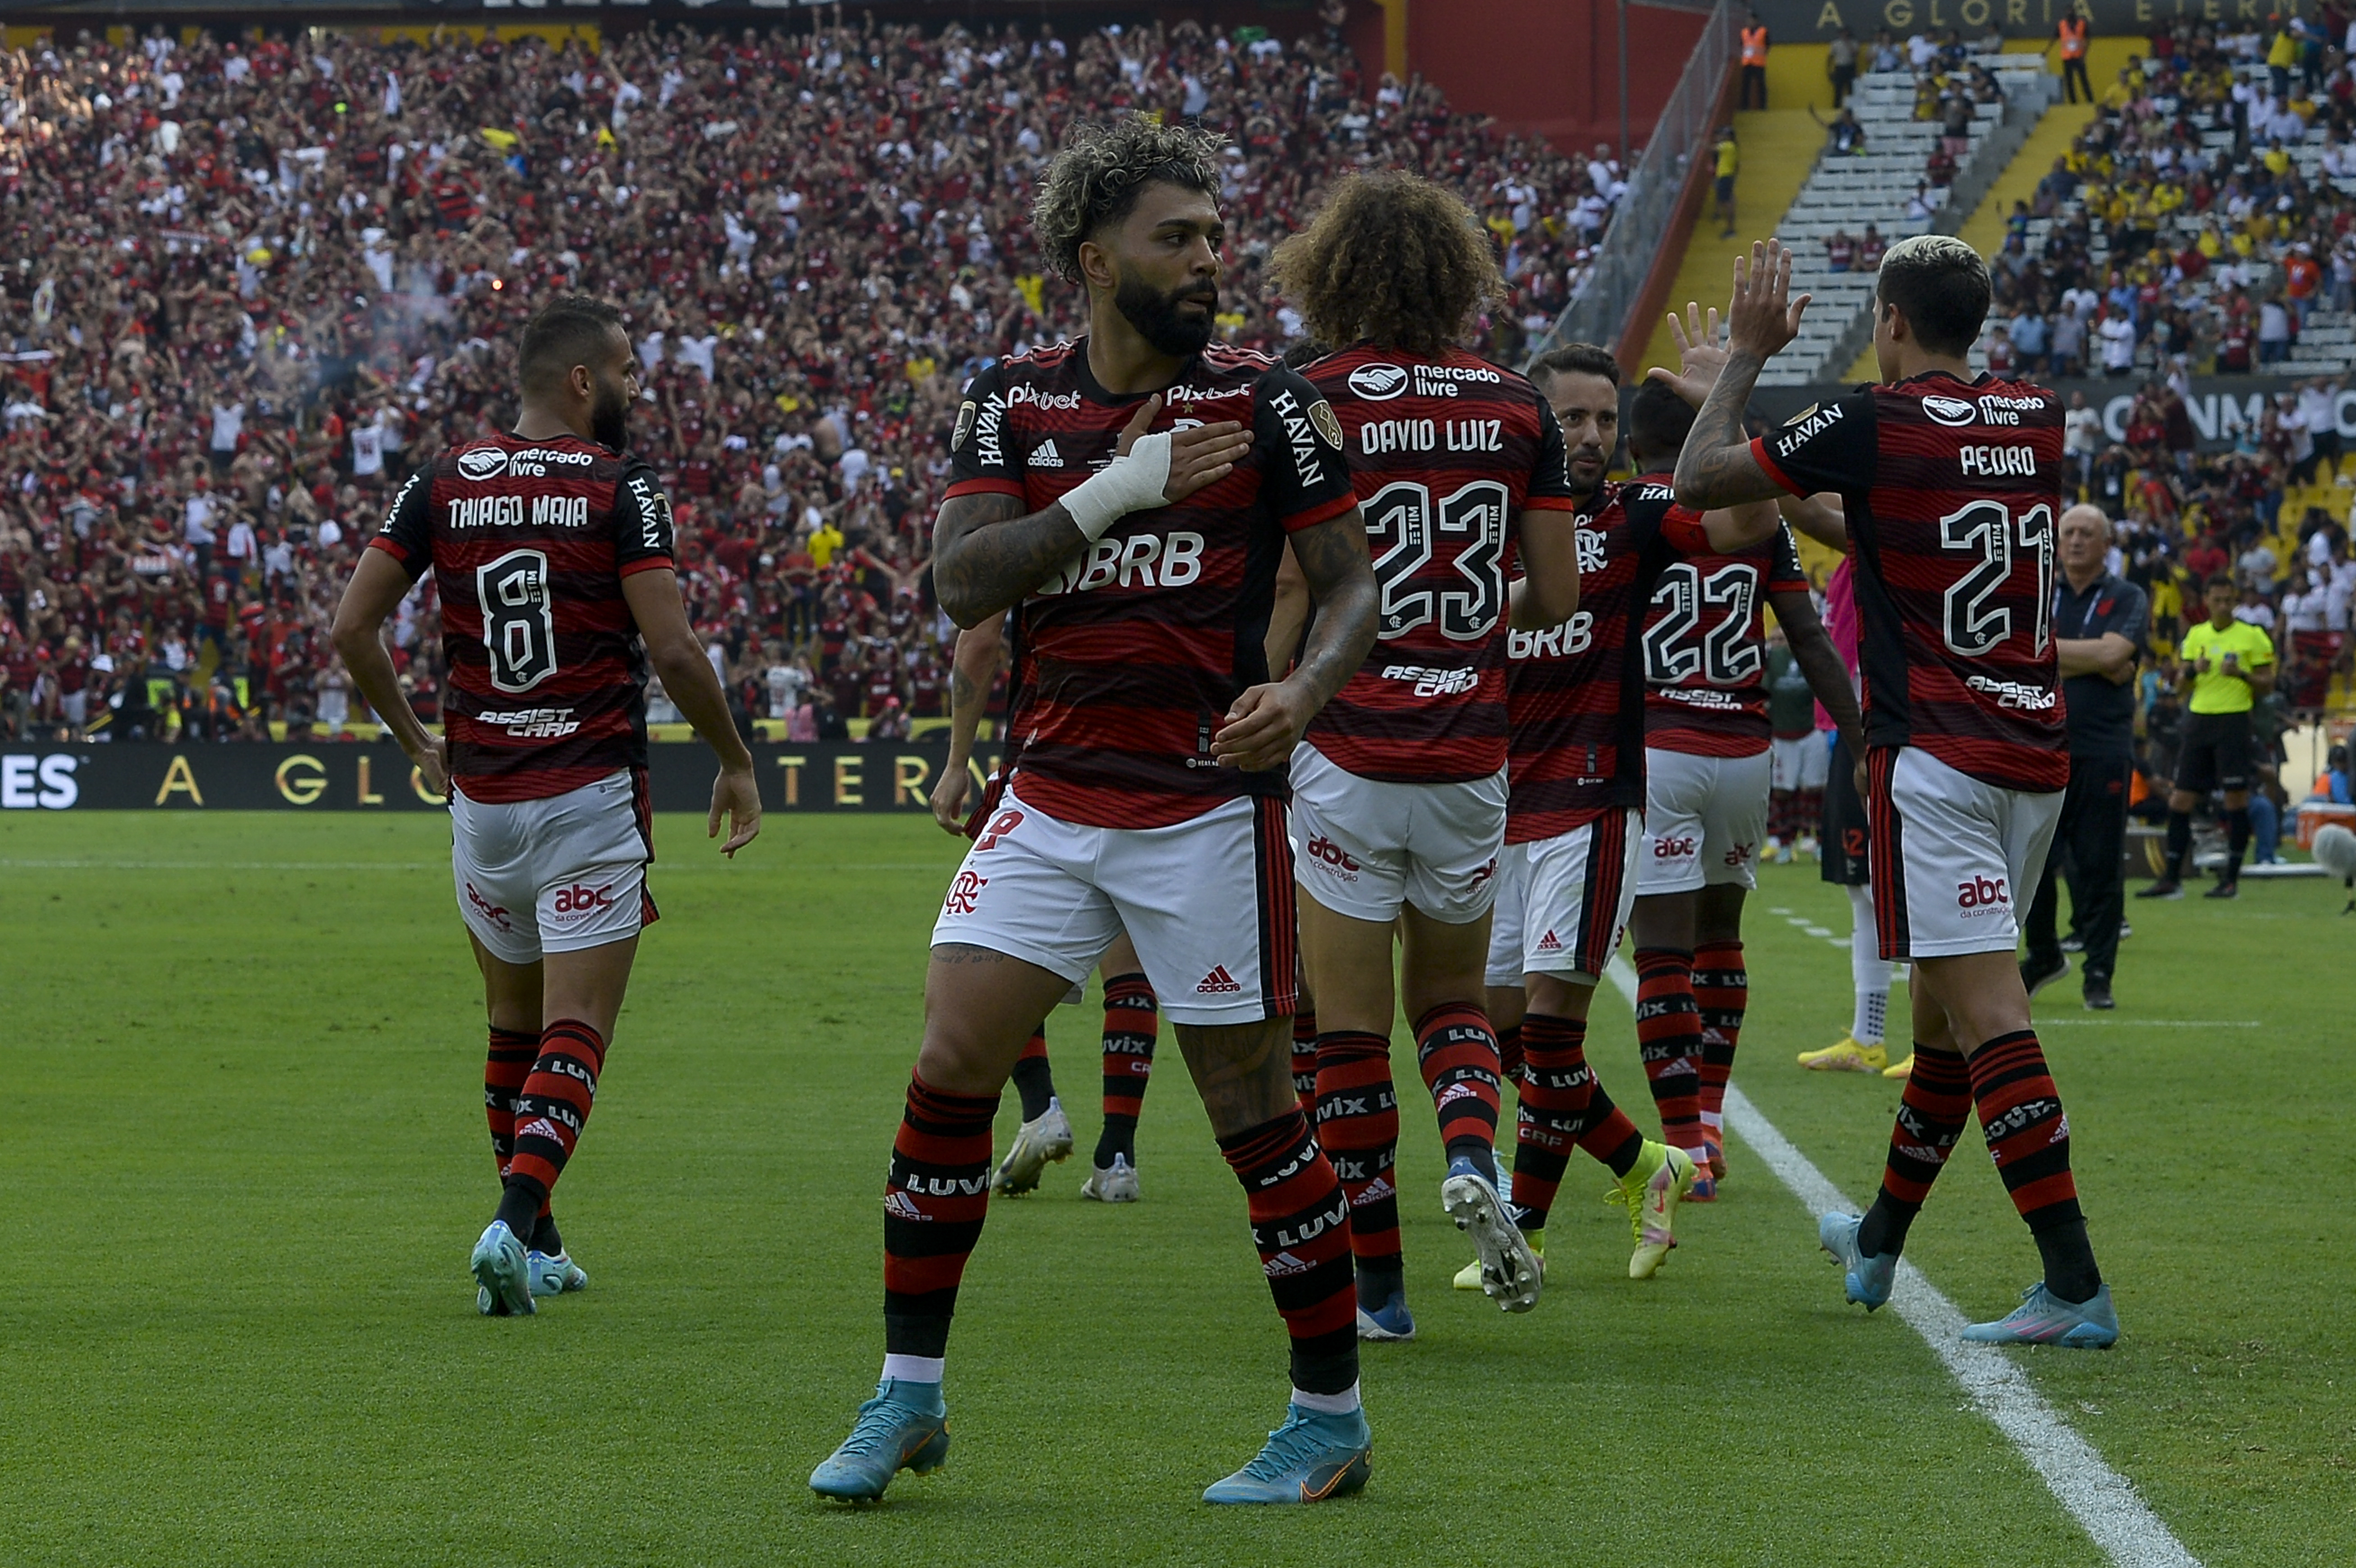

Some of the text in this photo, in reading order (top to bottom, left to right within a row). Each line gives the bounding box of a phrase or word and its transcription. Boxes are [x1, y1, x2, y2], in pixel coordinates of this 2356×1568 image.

[1816, 1, 1843, 29] A
[1414, 364, 1501, 384] mercado
[1415, 377, 1459, 397] livre
[1978, 394, 2045, 410] mercado
[1983, 407, 2020, 426] livre
[976, 391, 1007, 467] HAVAN
[1269, 389, 1325, 488] HAVAN
[1360, 419, 1503, 455] DAVID LUIZ
[1776, 403, 1844, 457] HAVAN
[509, 463, 545, 478] livre
[510, 447, 593, 466] mercado
[1027, 456, 1064, 468] adidas
[1960, 446, 2036, 476] PEDRO
[448, 494, 588, 529] THIAGO MAIA
[627, 477, 660, 549] HAVAN
[1078, 531, 1204, 591] BRB
[1358, 480, 1509, 640] 23
[1940, 499, 2055, 659] 21
[476, 548, 557, 693] 8
[1642, 562, 1761, 685] 22
[475, 708, 574, 725] ASSIST
[506, 722, 581, 737] CARD
[155, 755, 203, 806] A
[554, 883, 613, 913] abc
[1957, 874, 2009, 909] abc
[1196, 982, 1242, 994] adidas
